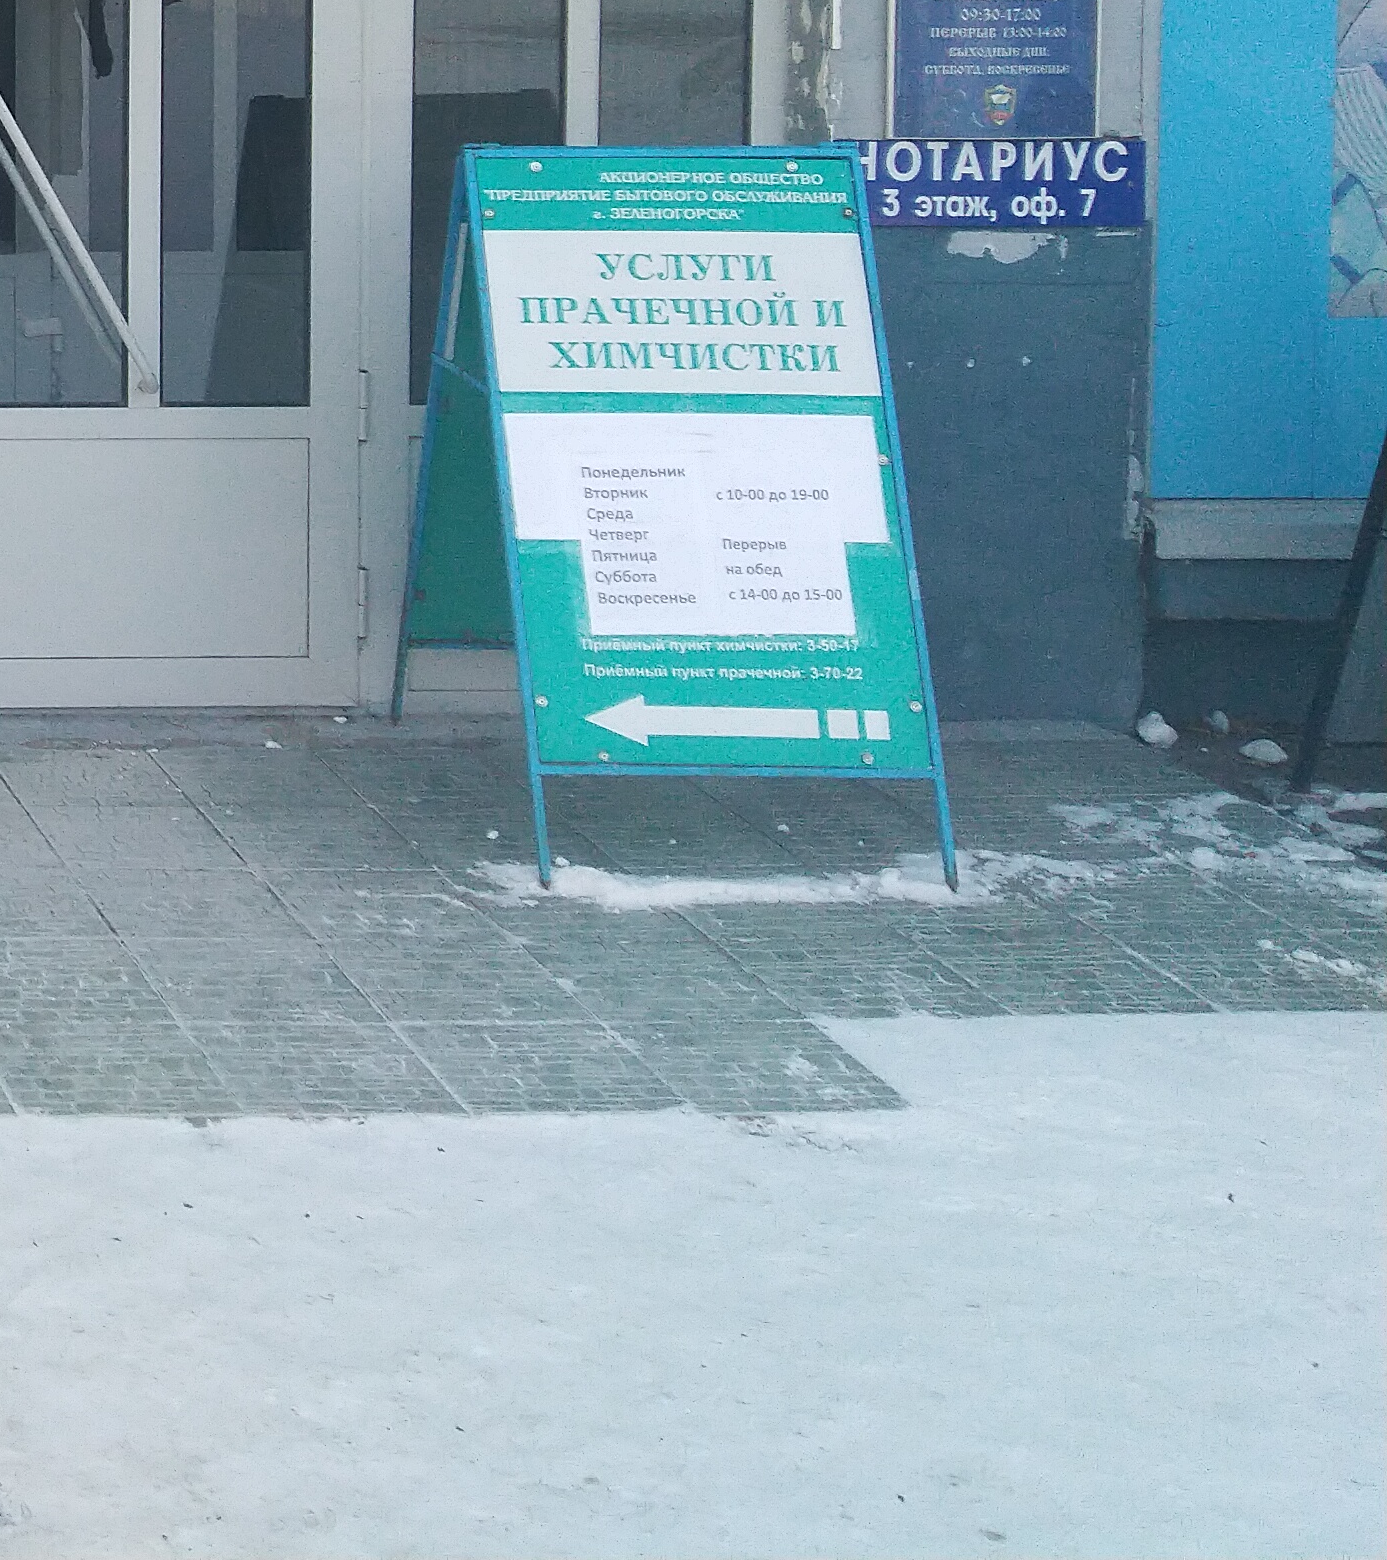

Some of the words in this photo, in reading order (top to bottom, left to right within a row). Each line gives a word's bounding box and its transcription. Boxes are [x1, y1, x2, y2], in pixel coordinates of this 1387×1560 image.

[729, 172, 824, 186] ОБЩЕСТВО
[615, 189, 707, 203] БЫТОВОГО
[882, 188, 901, 217] 3
[914, 195, 997, 222] этаж,
[1011, 189, 1066, 224] оф.
[1081, 189, 1097, 216] 7
[594, 252, 777, 283] УСЛУГИ
[519, 292, 798, 327] ПРАЧЕЧНОЙ
[814, 299, 848, 328] И
[548, 341, 841, 373] ХИМЧИСТКИ
[580, 465, 686, 481] Понедельник
[584, 486, 649, 501] Вторник
[726, 488, 765, 501] 10-00
[768, 490, 787, 503] до
[791, 488, 829, 501] 19-00
[586, 507, 634, 522] Среда
[589, 528, 649, 542] Четверг
[722, 538, 787, 553] Перерыв
[592, 549, 657, 564] Пятница
[595, 570, 657, 585] Суббота
[726, 565, 742, 576] на
[745, 563, 783, 578] обед
[598, 590, 697, 606] Воскресенье
[739, 587, 779, 601] 14-00
[782, 589, 800, 603] до
[804, 588, 843, 601] 15-00
[669, 641, 712, 653] пункт
[671, 667, 715, 681] пункт
